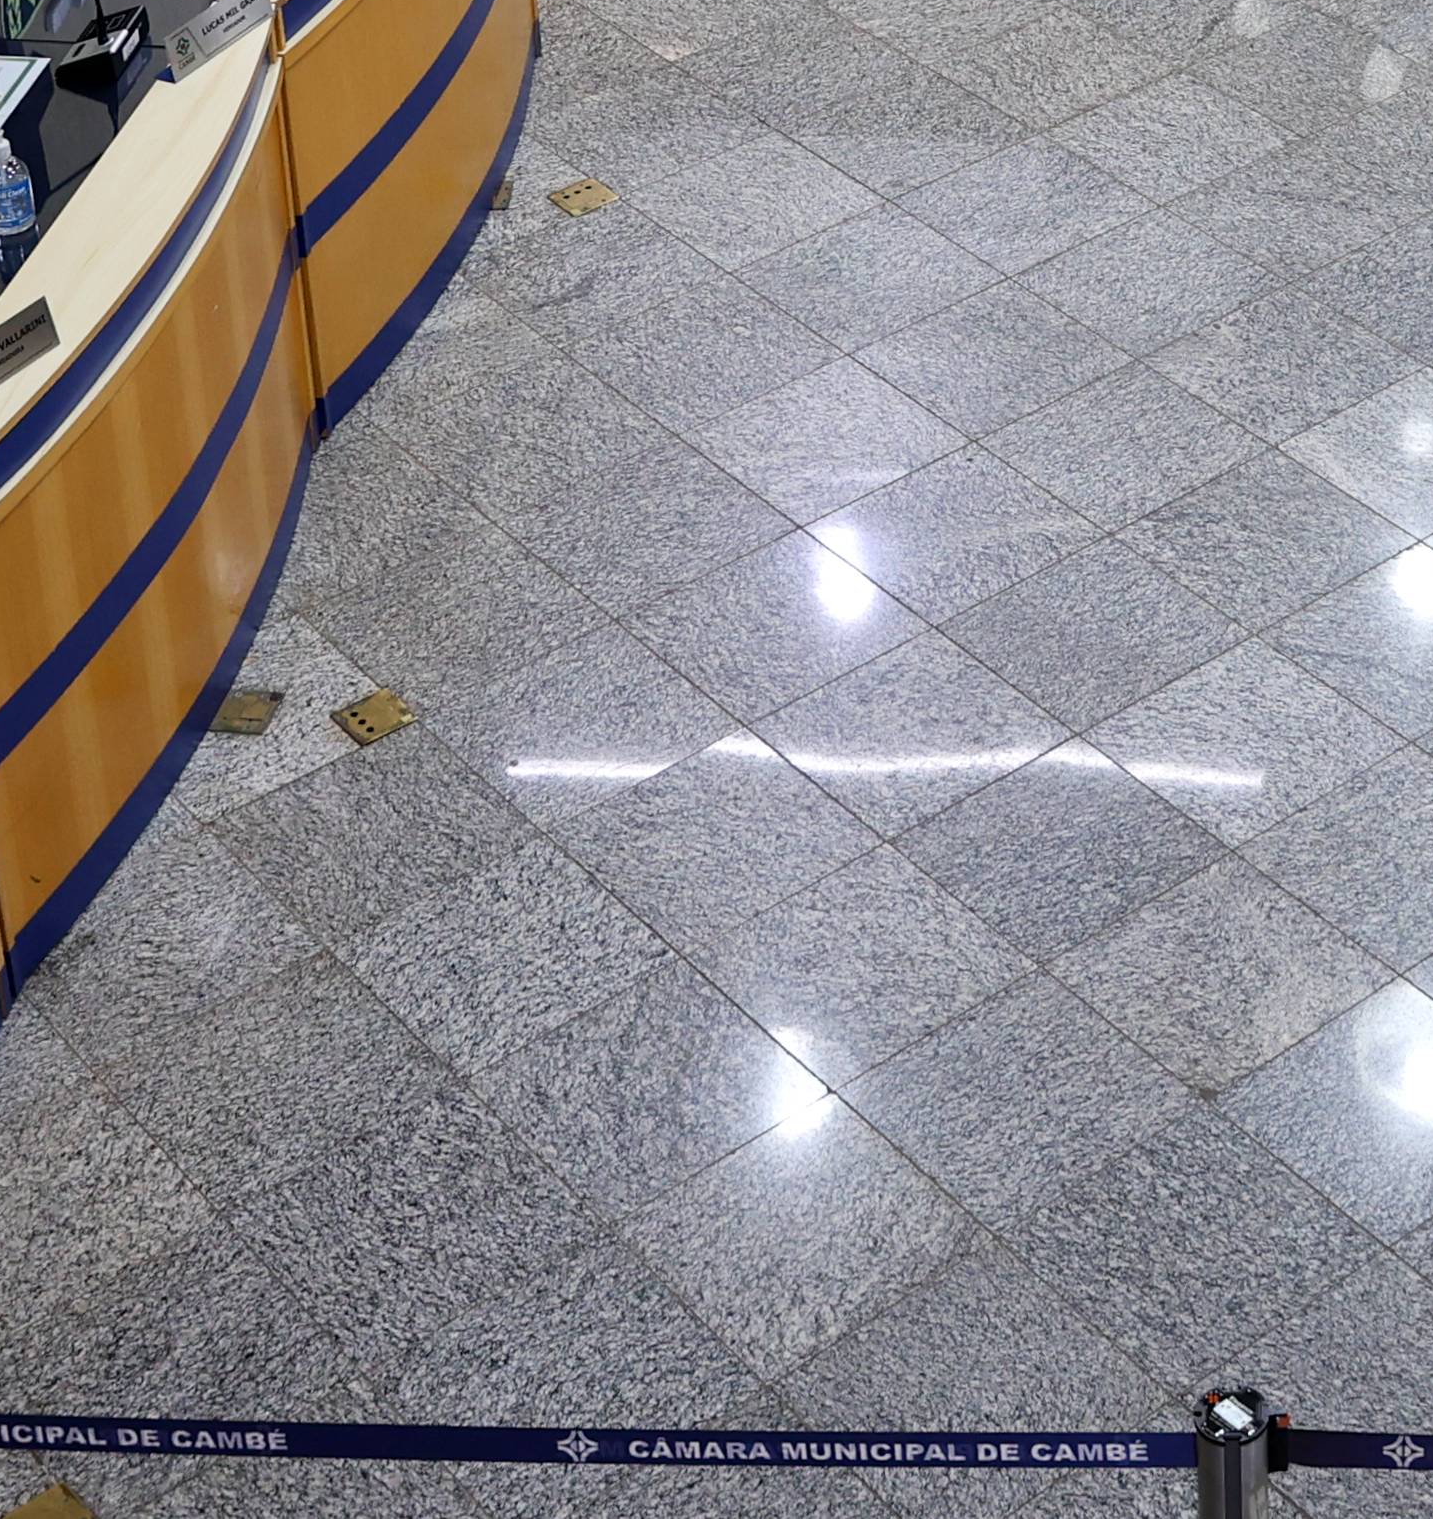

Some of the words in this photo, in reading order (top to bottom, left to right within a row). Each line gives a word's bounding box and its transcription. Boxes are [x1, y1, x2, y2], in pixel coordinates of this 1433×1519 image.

[201, 14, 225, 36] LUCAS
[226, 7, 240, 20] MIL
[117, 1428, 161, 1448] DE
[171, 1427, 288, 1451] CAMBÉ
[628, 1438, 771, 1460] CÂMARA
[782, 1442, 966, 1462] MUNICIPAL
[977, 1443, 1020, 1462] DE
[1031, 1439, 1149, 1463] CAMBÉ
